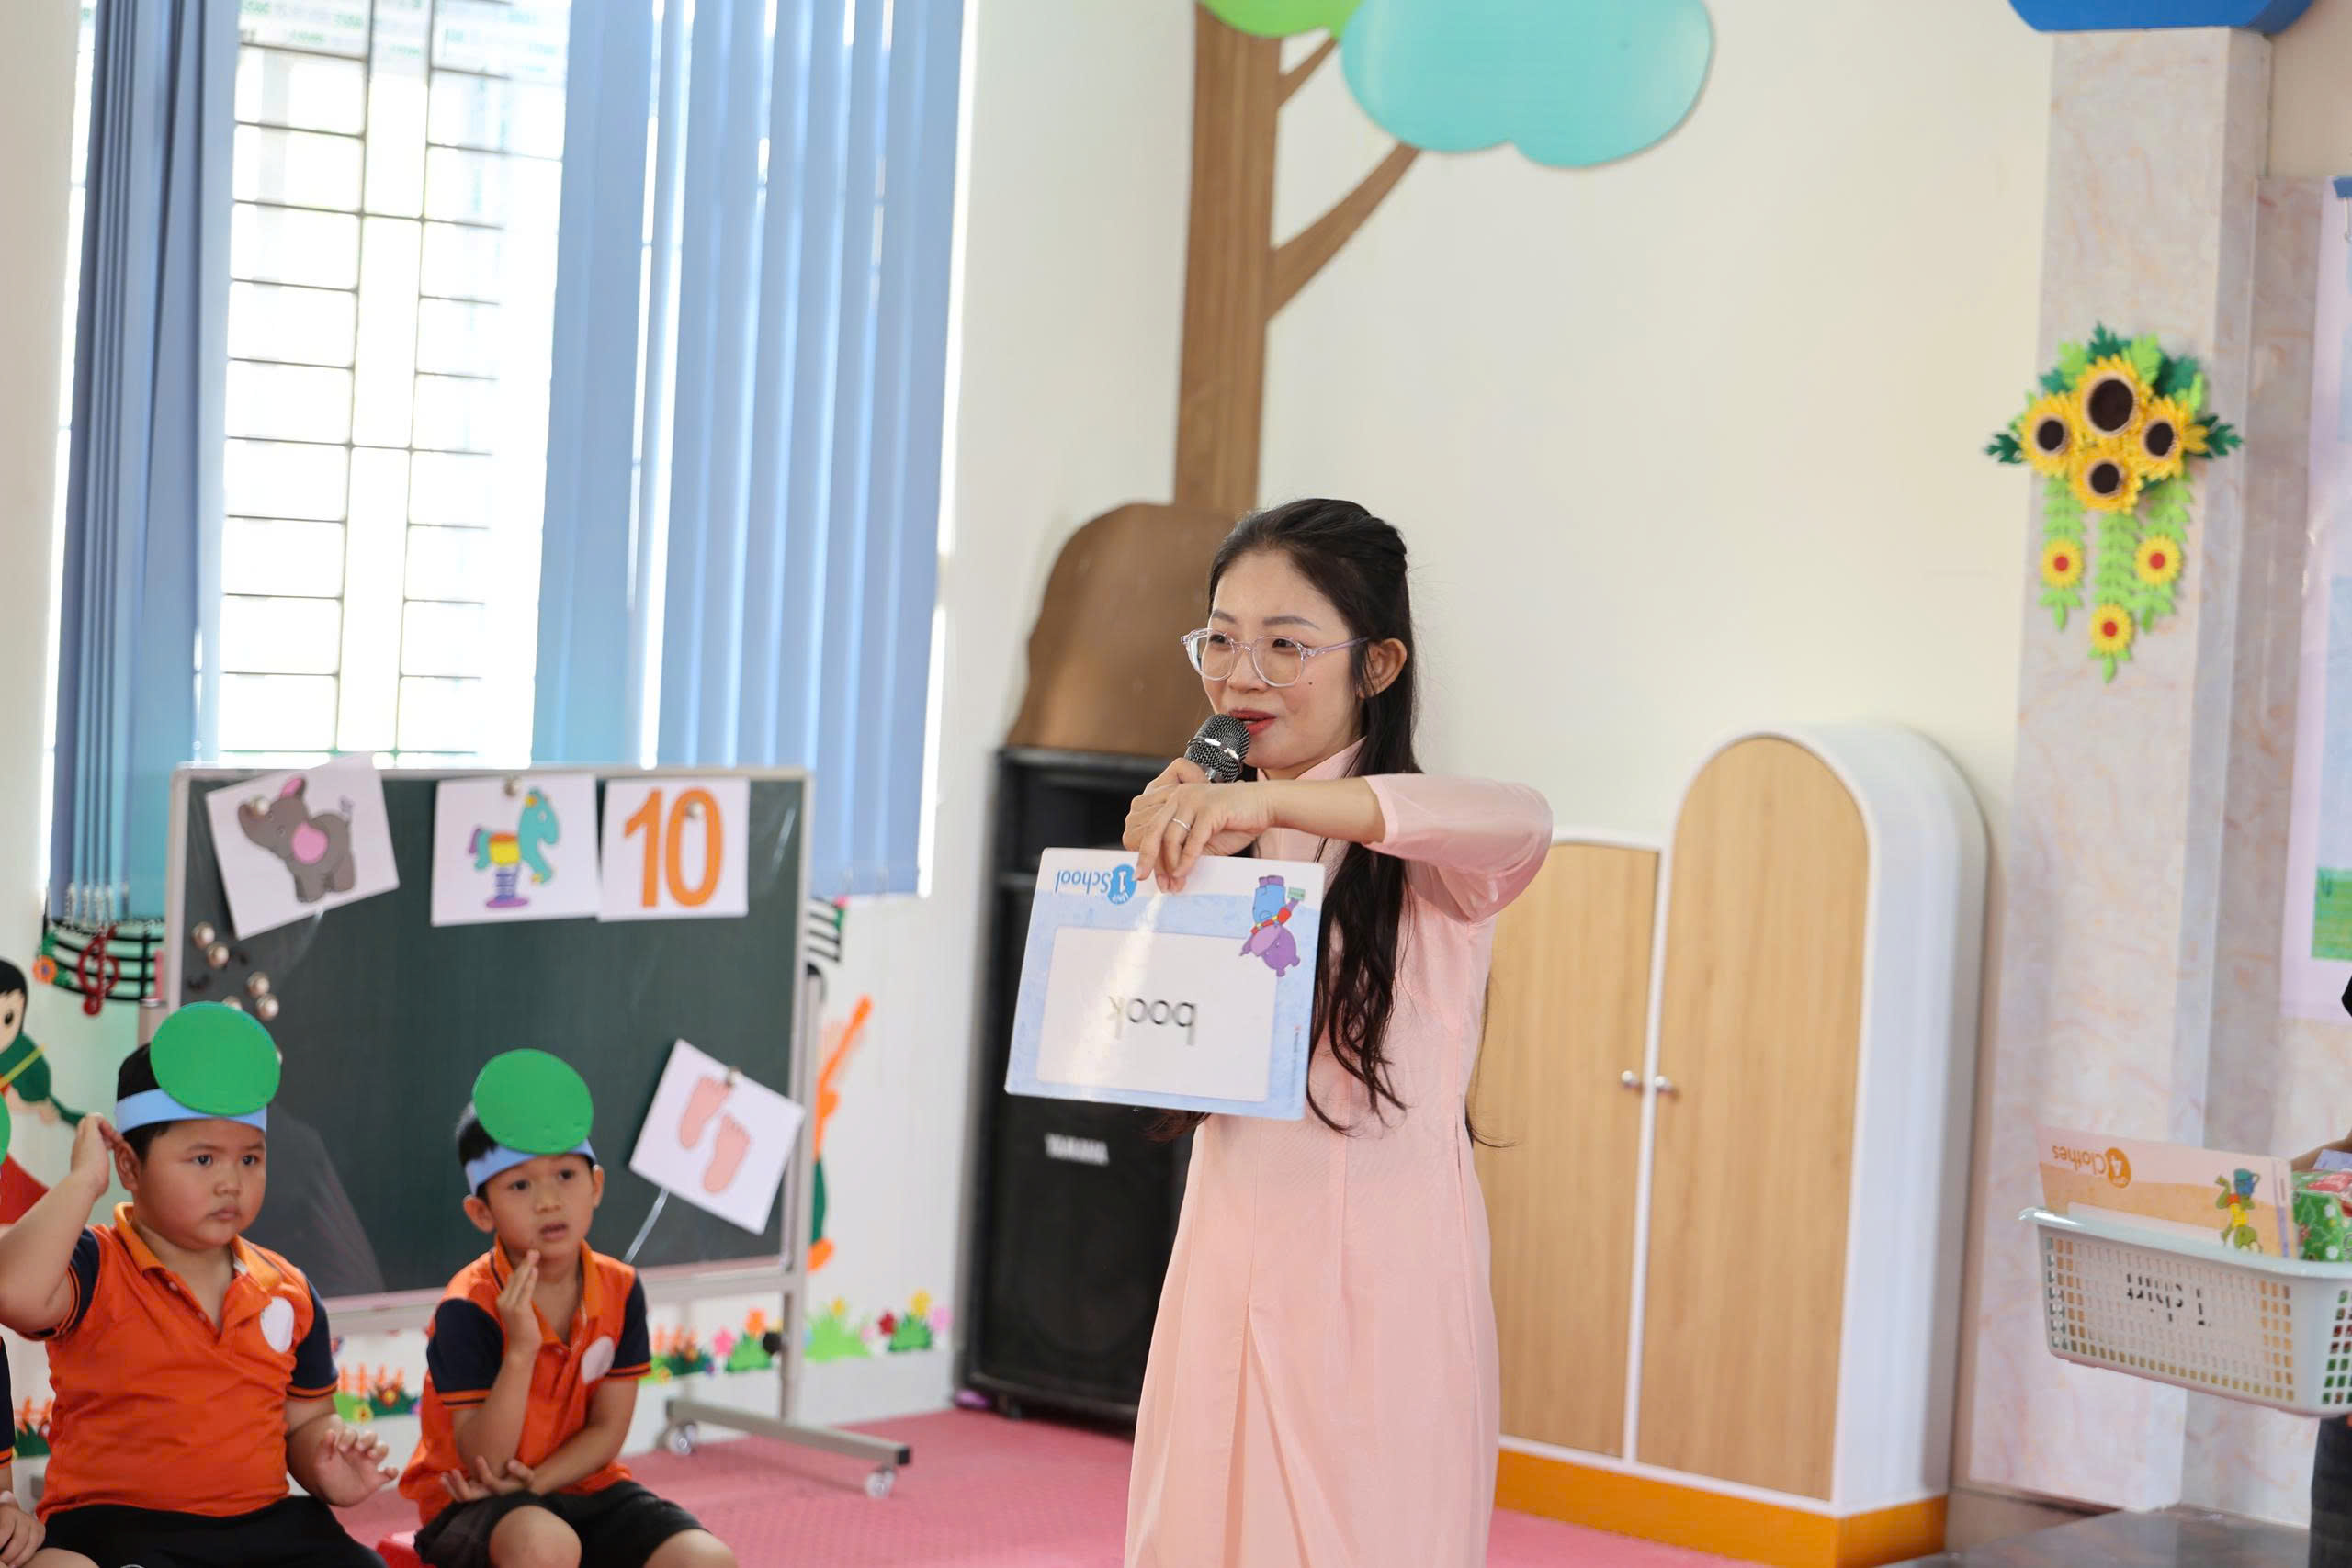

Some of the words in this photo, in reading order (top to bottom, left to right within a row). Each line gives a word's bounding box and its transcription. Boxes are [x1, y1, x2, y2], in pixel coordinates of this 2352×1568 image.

[624, 788, 723, 908] 10
[1054, 869, 1111, 895] School
[1118, 870, 1126, 893] 1
[1107, 996, 1197, 1046] book
[2052, 1145, 2107, 1176] Clothes
[2110, 1154, 2123, 1177] 4
